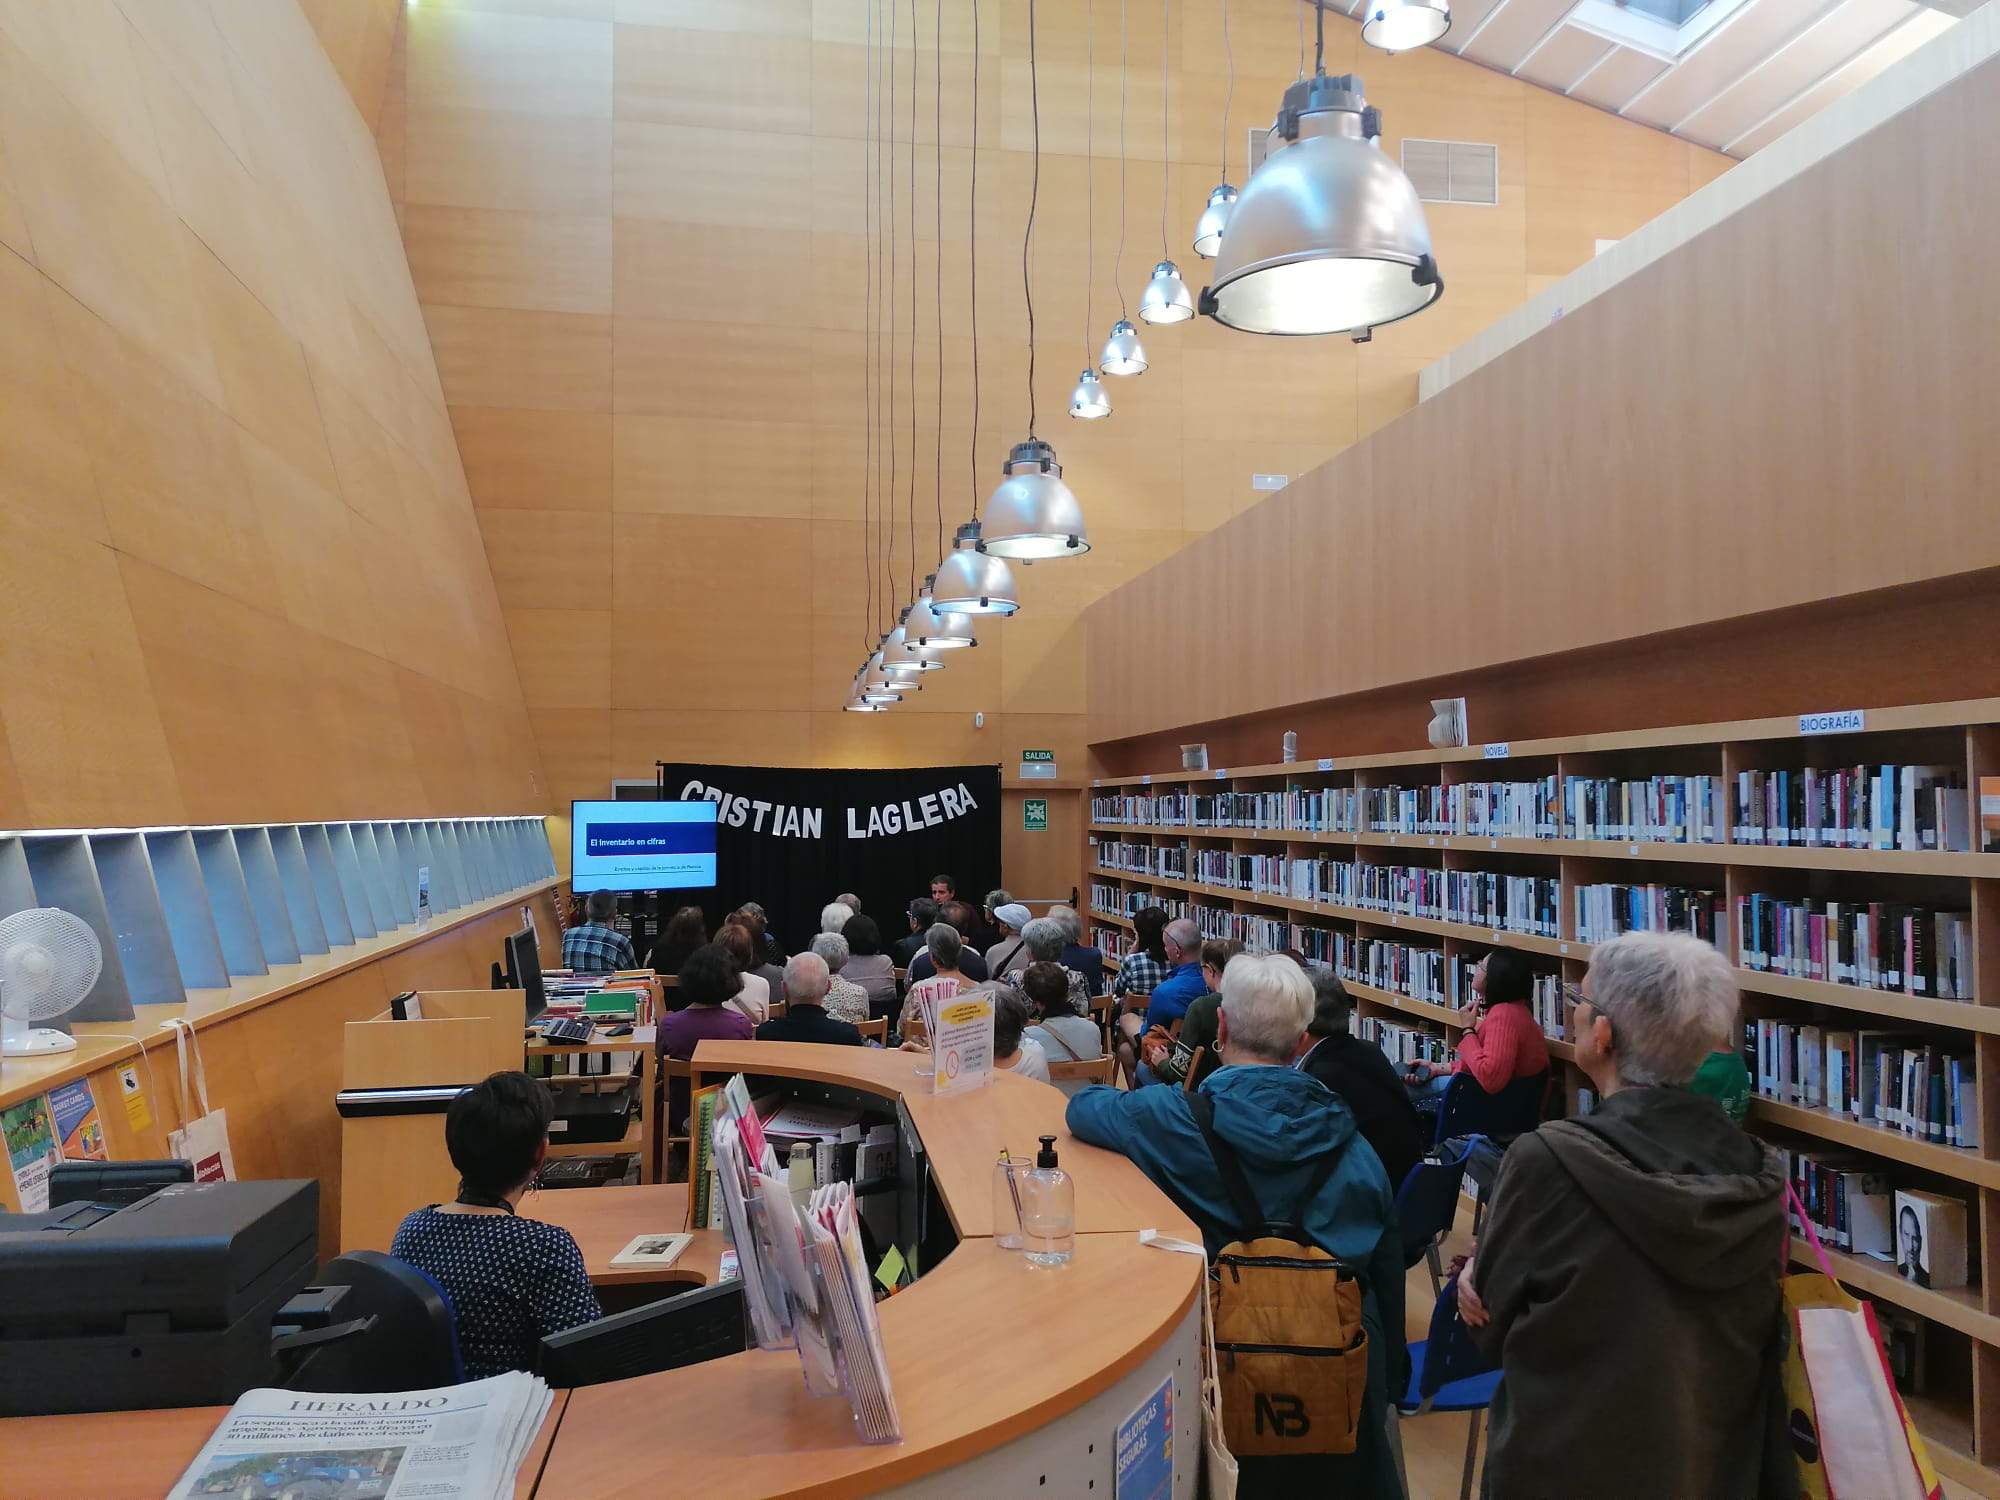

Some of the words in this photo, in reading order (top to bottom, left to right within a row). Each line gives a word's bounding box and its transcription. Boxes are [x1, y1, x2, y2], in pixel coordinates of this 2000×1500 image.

[1801, 712, 1861, 731] BIOGRAFÍA
[1025, 752, 1051, 760] SALIDA
[1485, 746, 1508, 756] NOVELA
[847, 783, 978, 839] LAGLERA
[590, 839, 598, 847] El
[646, 837, 666, 846] cifras
[289, 1397, 449, 1411] HERALDO
[1254, 1392, 1311, 1437] NB
[241, 1432, 296, 1440] millones
